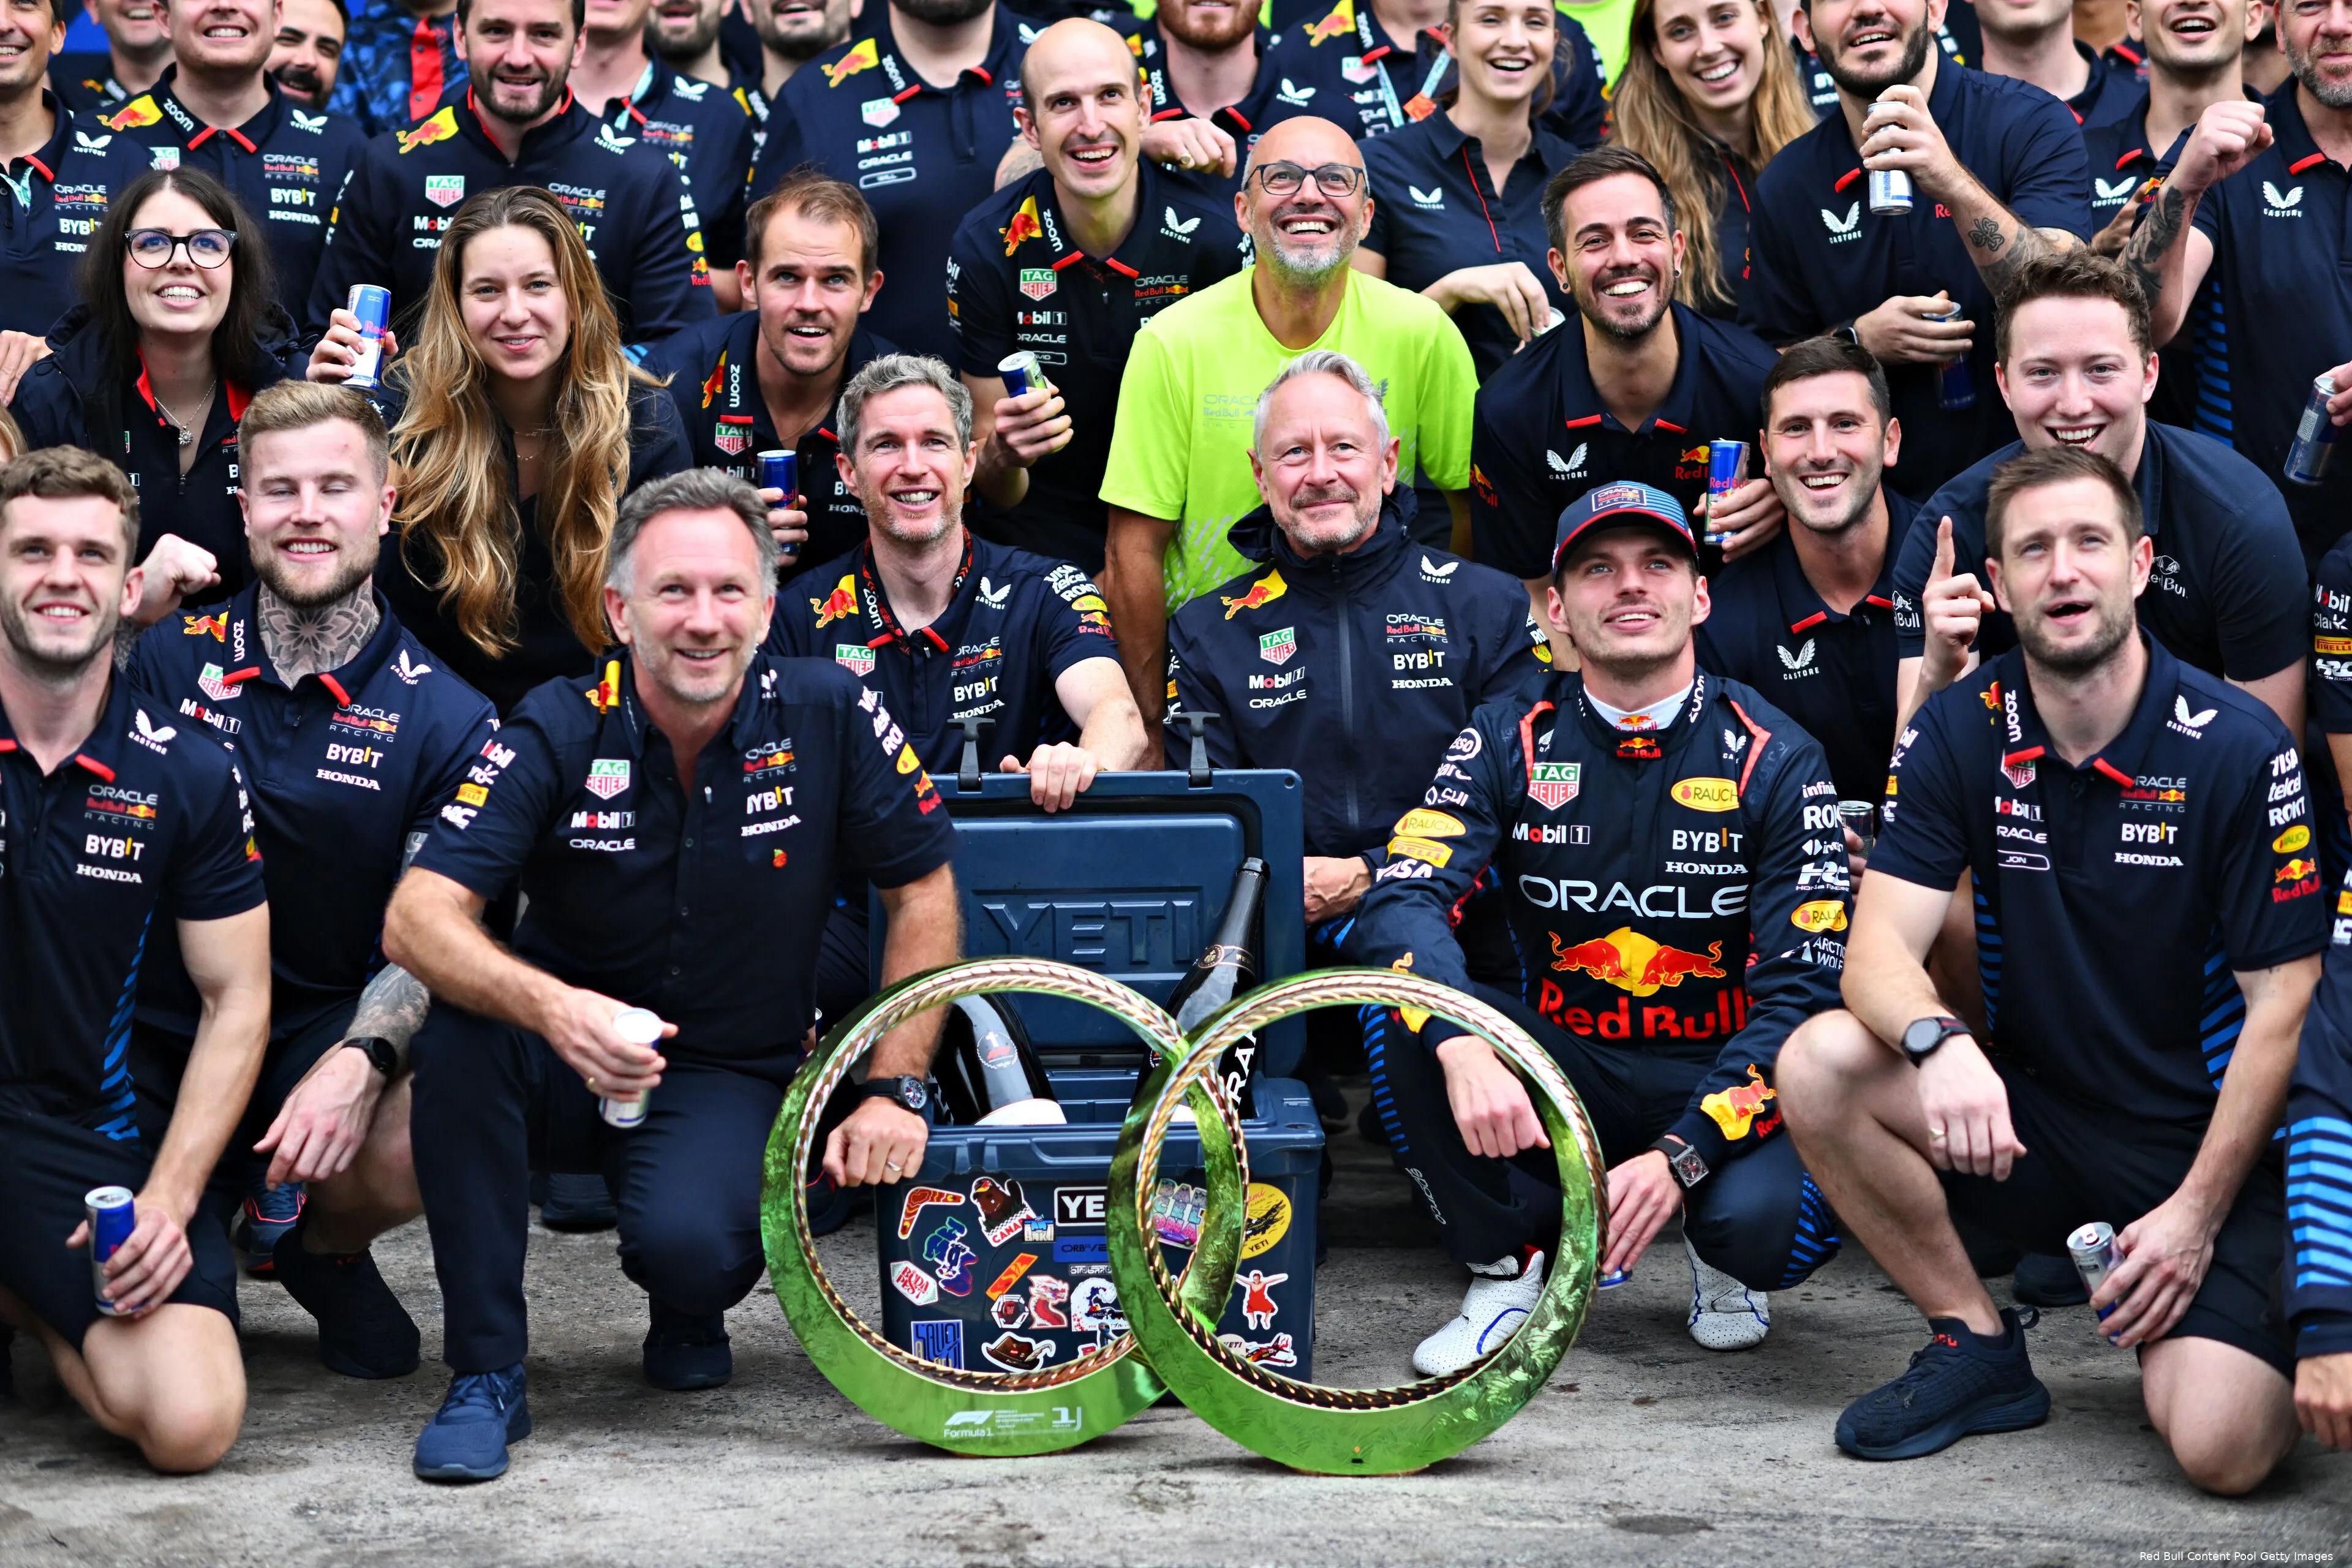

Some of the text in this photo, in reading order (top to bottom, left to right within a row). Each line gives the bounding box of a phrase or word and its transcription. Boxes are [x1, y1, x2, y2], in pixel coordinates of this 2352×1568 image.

[882, 54, 906, 91] zoom
[1150, 69, 1167, 105] zoom
[162, 98, 195, 132] zoom
[857, 134, 897, 153] Mobil
[263, 154, 318, 166] ORACLE
[858, 151, 913, 170] ORACLE
[55, 184, 107, 194] ORACLE
[429, 178, 461, 188] TAG
[548, 183, 606, 200] ORACLE
[270, 188, 316, 207] BYBIT
[268, 210, 321, 225] HONDA
[1935, 204, 1951, 219] Re
[2263, 208, 2303, 218] CASTORE
[414, 216, 452, 230] Mobi
[1042, 209, 1063, 252] zoom
[413, 238, 442, 248] ORA
[1160, 227, 1192, 244] CASTORE
[1829, 231, 1862, 244] CASTORE
[55, 242, 87, 252] HON
[1023, 270, 1054, 281] TAG
[1134, 274, 1188, 287] ORACLE
[1021, 282, 1055, 300] HEUER
[1134, 287, 1164, 298] Red Bull
[1135, 297, 1178, 308] RACIN
[729, 364, 741, 408] zoom
[1204, 394, 1257, 405] ORACL
[718, 425, 750, 435] TAG
[1549, 471, 1588, 480] CASTORE
[1675, 466, 1702, 480] Red
[1709, 477, 1729, 488] Red
[1598, 488, 1639, 497] ORACLE
[1599, 497, 1640, 507] RACING
[1044, 565, 1078, 582] VISA
[1052, 572, 1087, 594] telcel
[975, 595, 1006, 610] CASTORE
[2315, 583, 2351, 613] Mobil
[863, 588, 883, 629] zoom
[1386, 613, 1444, 627] ORACLE
[1898, 612, 1920, 628] Bull
[1262, 630, 1292, 646] TAG
[1386, 624, 1420, 635] Red Bull
[233, 619, 245, 662] zoom
[955, 636, 1000, 657] ORACLE
[2317, 638, 2351, 651] PIRELLI
[839, 646, 872, 659] TAG
[952, 654, 979, 667] Red Bull
[1262, 643, 1296, 663] HEUER
[1393, 649, 1445, 670] BYBIT
[390, 665, 418, 685] CASTORE
[837, 660, 873, 675] HEUER
[951, 657, 1003, 677] RACING
[1783, 666, 1820, 681] CASTORE
[200, 678, 241, 698] HEUER
[1249, 671, 1292, 689] Mobil
[1392, 677, 1453, 689] HONDA
[954, 677, 998, 703] BYBIT
[1250, 689, 1307, 709] ORACLE
[179, 698, 224, 728] Mobil
[337, 703, 400, 723] ORACLE
[953, 699, 1005, 718] HONDA
[2005, 690, 2022, 742] zoom
[329, 725, 394, 743] RACING
[2166, 720, 2202, 739] CASTORE
[326, 743, 383, 768] BYBIT
[1617, 747, 1661, 758] Red Bull
[592, 761, 627, 775] TAG
[2270, 748, 2298, 777] VISA
[315, 769, 381, 791] HONDA
[744, 764, 797, 783] RCING
[1535, 766, 1575, 780] TAG
[2135, 775, 2187, 788] RACLE
[89, 785, 158, 805] ORACLE
[587, 776, 628, 797] HEUER
[1694, 787, 1738, 801] RAUCH
[2268, 771, 2301, 802] telcel
[1529, 783, 1576, 809] HEUER
[2119, 803, 2185, 812] RACING
[2269, 796, 2305, 827] ROKT
[85, 812, 154, 829] RACING
[571, 812, 620, 829] Mobil
[741, 815, 801, 837] HONDA
[1409, 817, 1455, 834] RAUCH
[1803, 804, 1842, 830] ROK
[1512, 822, 1566, 843] Mobil
[1673, 827, 1743, 853] BYBIT
[1996, 826, 2048, 843] RACLE
[2121, 822, 2178, 844] BYBIT
[86, 834, 144, 860] BYBIT
[570, 838, 635, 851] ORACLE
[1665, 861, 1748, 875] HONDA
[2114, 853, 2184, 866] HONDA
[76, 864, 142, 884] HONDA
[1376, 859, 1433, 882] VISA
[1519, 875, 1749, 918] ORACLE
[2272, 882, 2301, 903] Red
[981, 901, 1194, 965] YETI
[1539, 978, 1746, 1038] Red Bull
[1404, 1167, 1446, 1225] sparco
[1061, 1195, 1105, 1218] YE
[1248, 1238, 1269, 1253] YETI
[897, 1275, 925, 1298] PEST
[901, 1267, 929, 1290] BUDA
[944, 1428, 993, 1438] Formula 1
